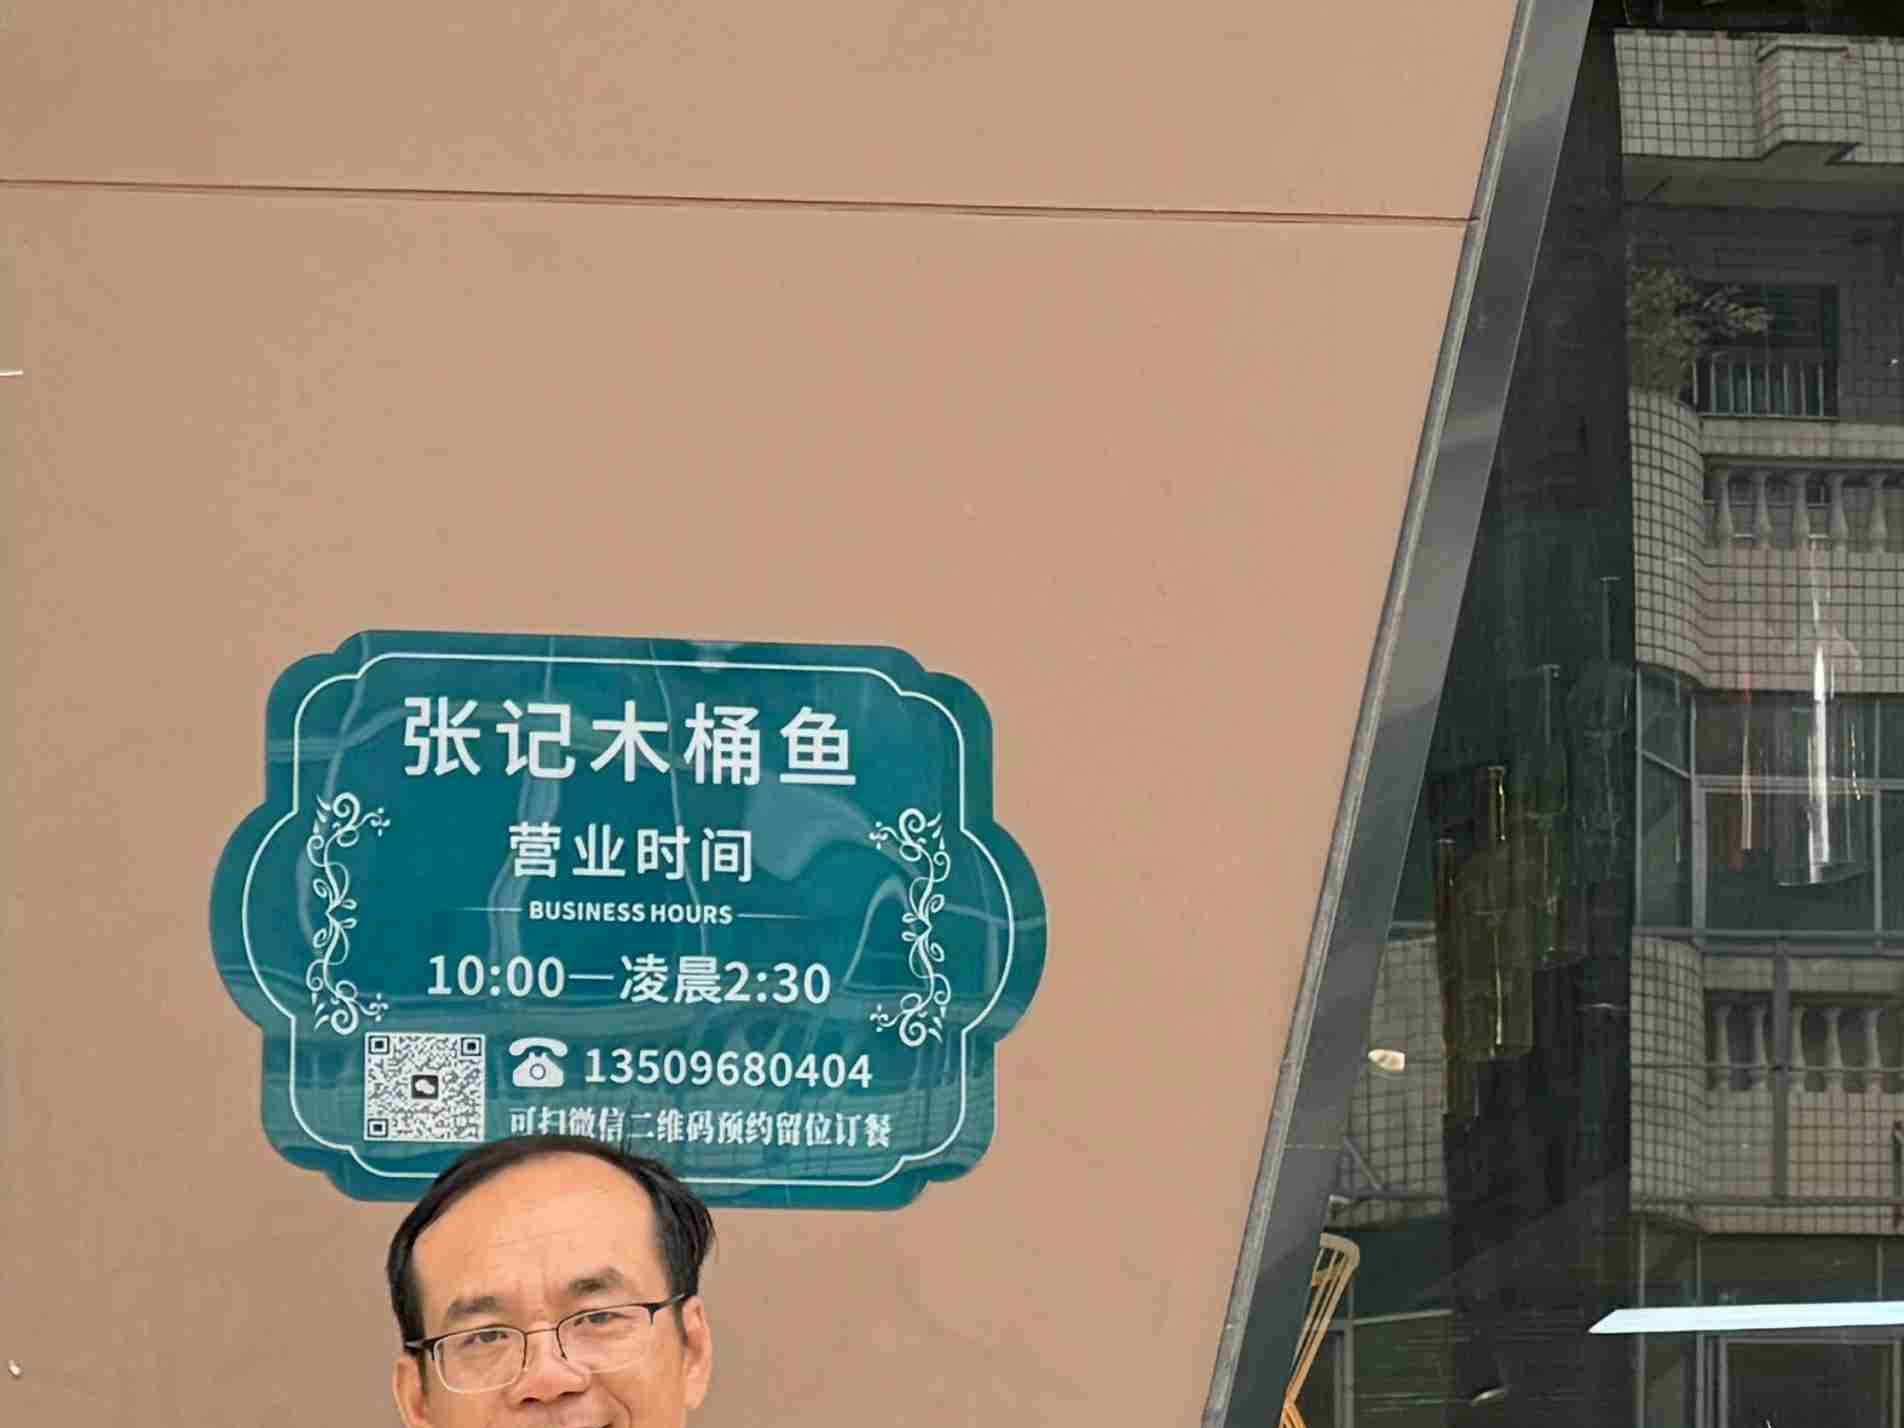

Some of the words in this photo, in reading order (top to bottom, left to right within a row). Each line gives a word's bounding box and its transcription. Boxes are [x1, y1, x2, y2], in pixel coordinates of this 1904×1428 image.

[401, 695, 857, 787] 张记木桶鱼
[508, 821, 754, 883] 营业时间
[528, 899, 648, 923] BUSINESS
[651, 904, 734, 927] HOURS
[583, 1048, 874, 1090] 13509680404
[509, 1106, 892, 1148] 可扫微信二维码预约留位订餐
